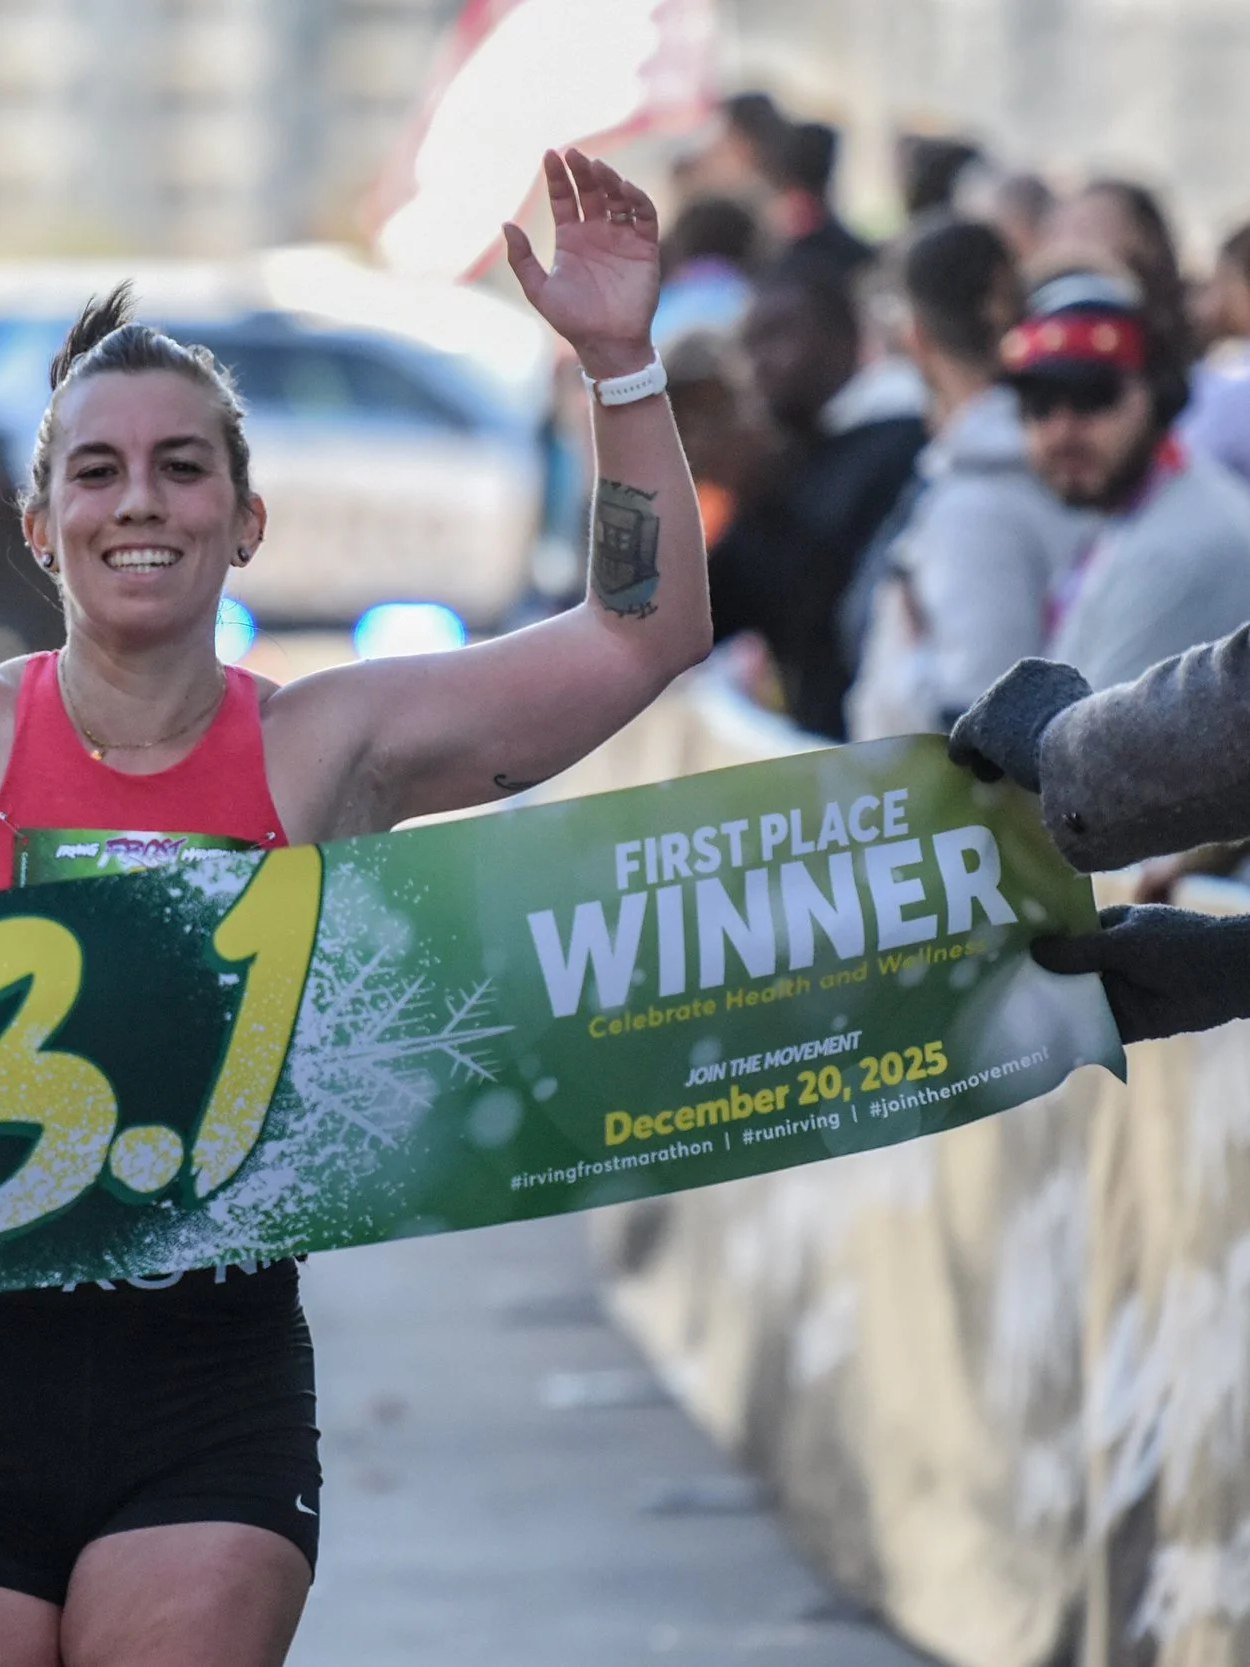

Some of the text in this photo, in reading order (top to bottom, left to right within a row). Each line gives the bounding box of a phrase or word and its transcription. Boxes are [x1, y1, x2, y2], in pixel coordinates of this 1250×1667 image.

[614, 788, 908, 890] FIRST PLACE
[526, 825, 1018, 1019] WINNER
[588, 938, 987, 1039] Celebrate Health and Wellness
[604, 1041, 949, 1147] December 20, 2025
[684, 1031, 862, 1088] JOIN THE MOVEMENT
[510, 1137, 714, 1191] #irvingfrostmarathon
[742, 1110, 842, 1147] #runirving
[869, 1046, 1050, 1119] #jointhemovement
